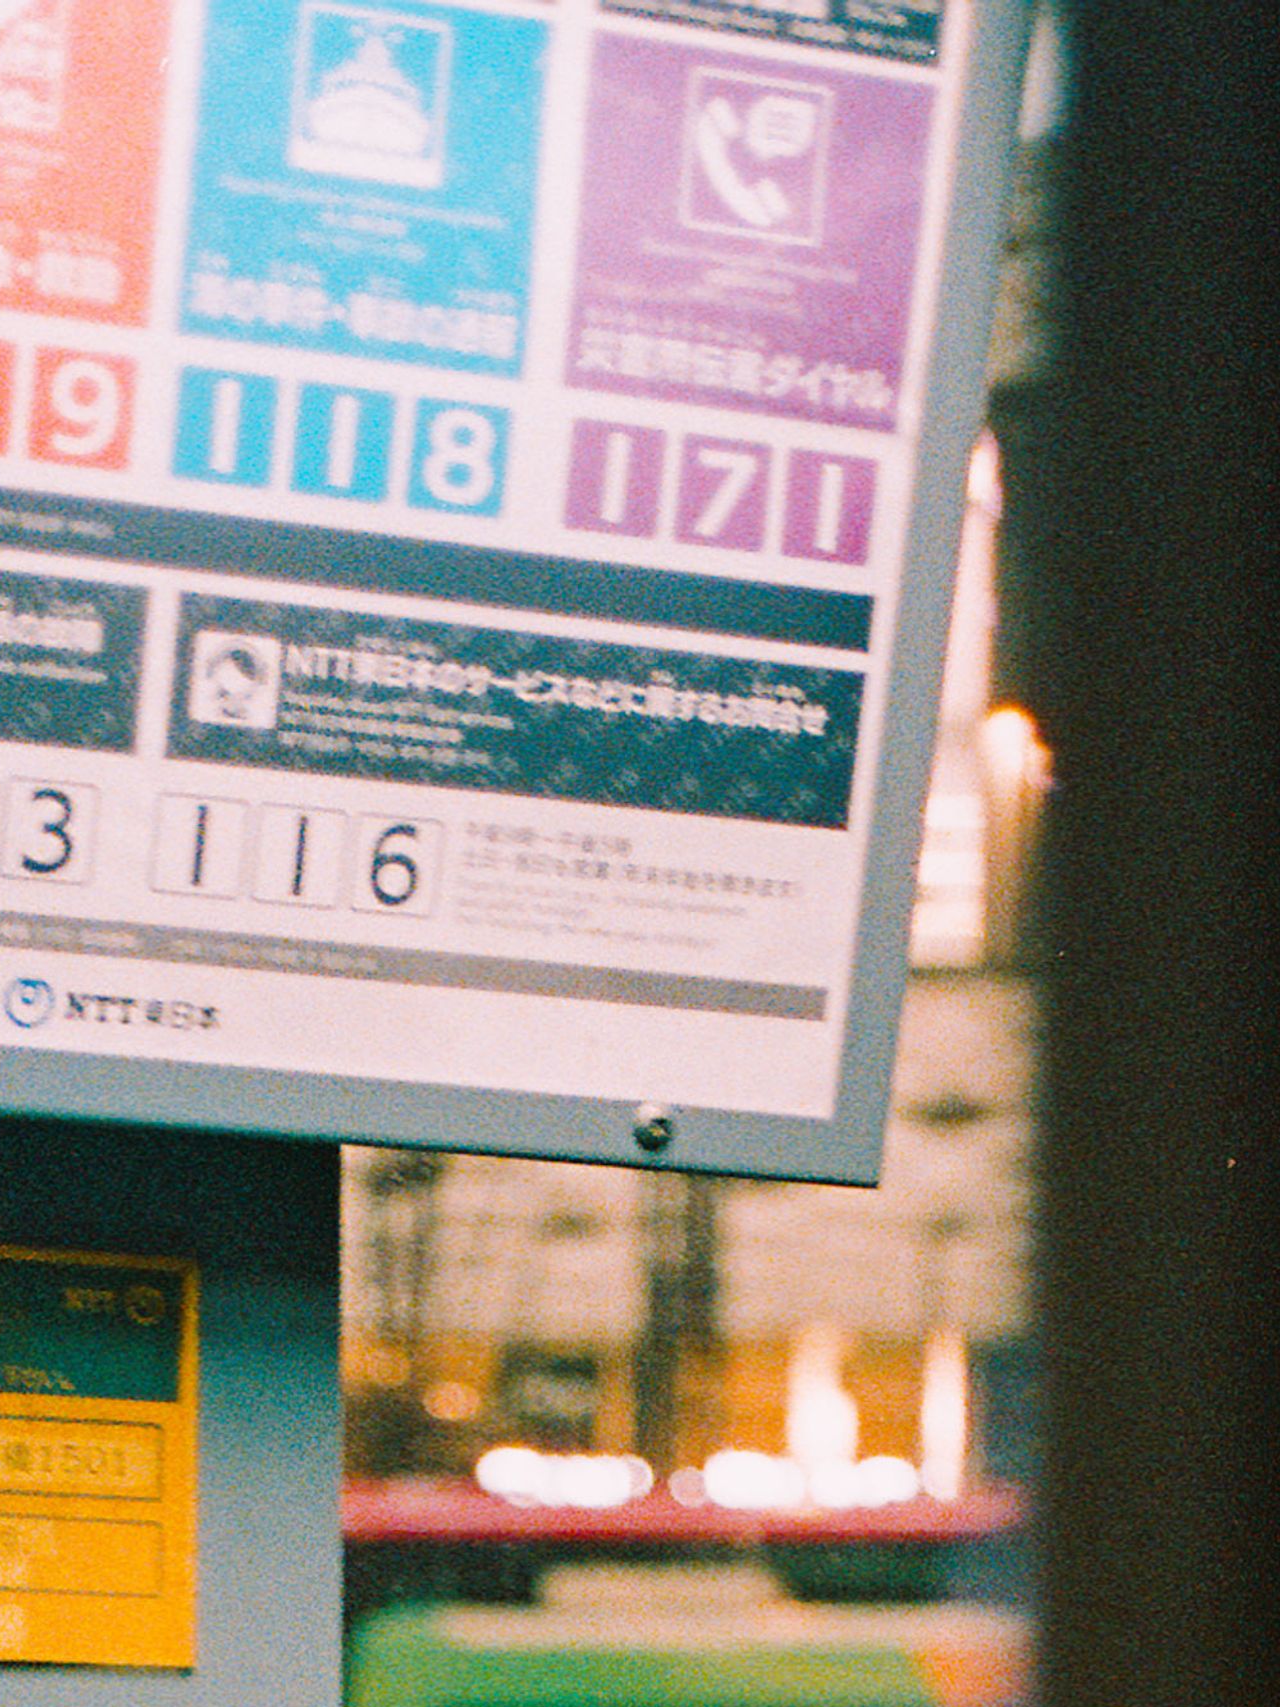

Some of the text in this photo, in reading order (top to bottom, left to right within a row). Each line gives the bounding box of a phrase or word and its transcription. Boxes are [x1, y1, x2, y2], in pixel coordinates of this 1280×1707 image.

[212, 378, 495, 508] 118
[601, 431, 844, 554] 171
[191, 803, 419, 907] 116
